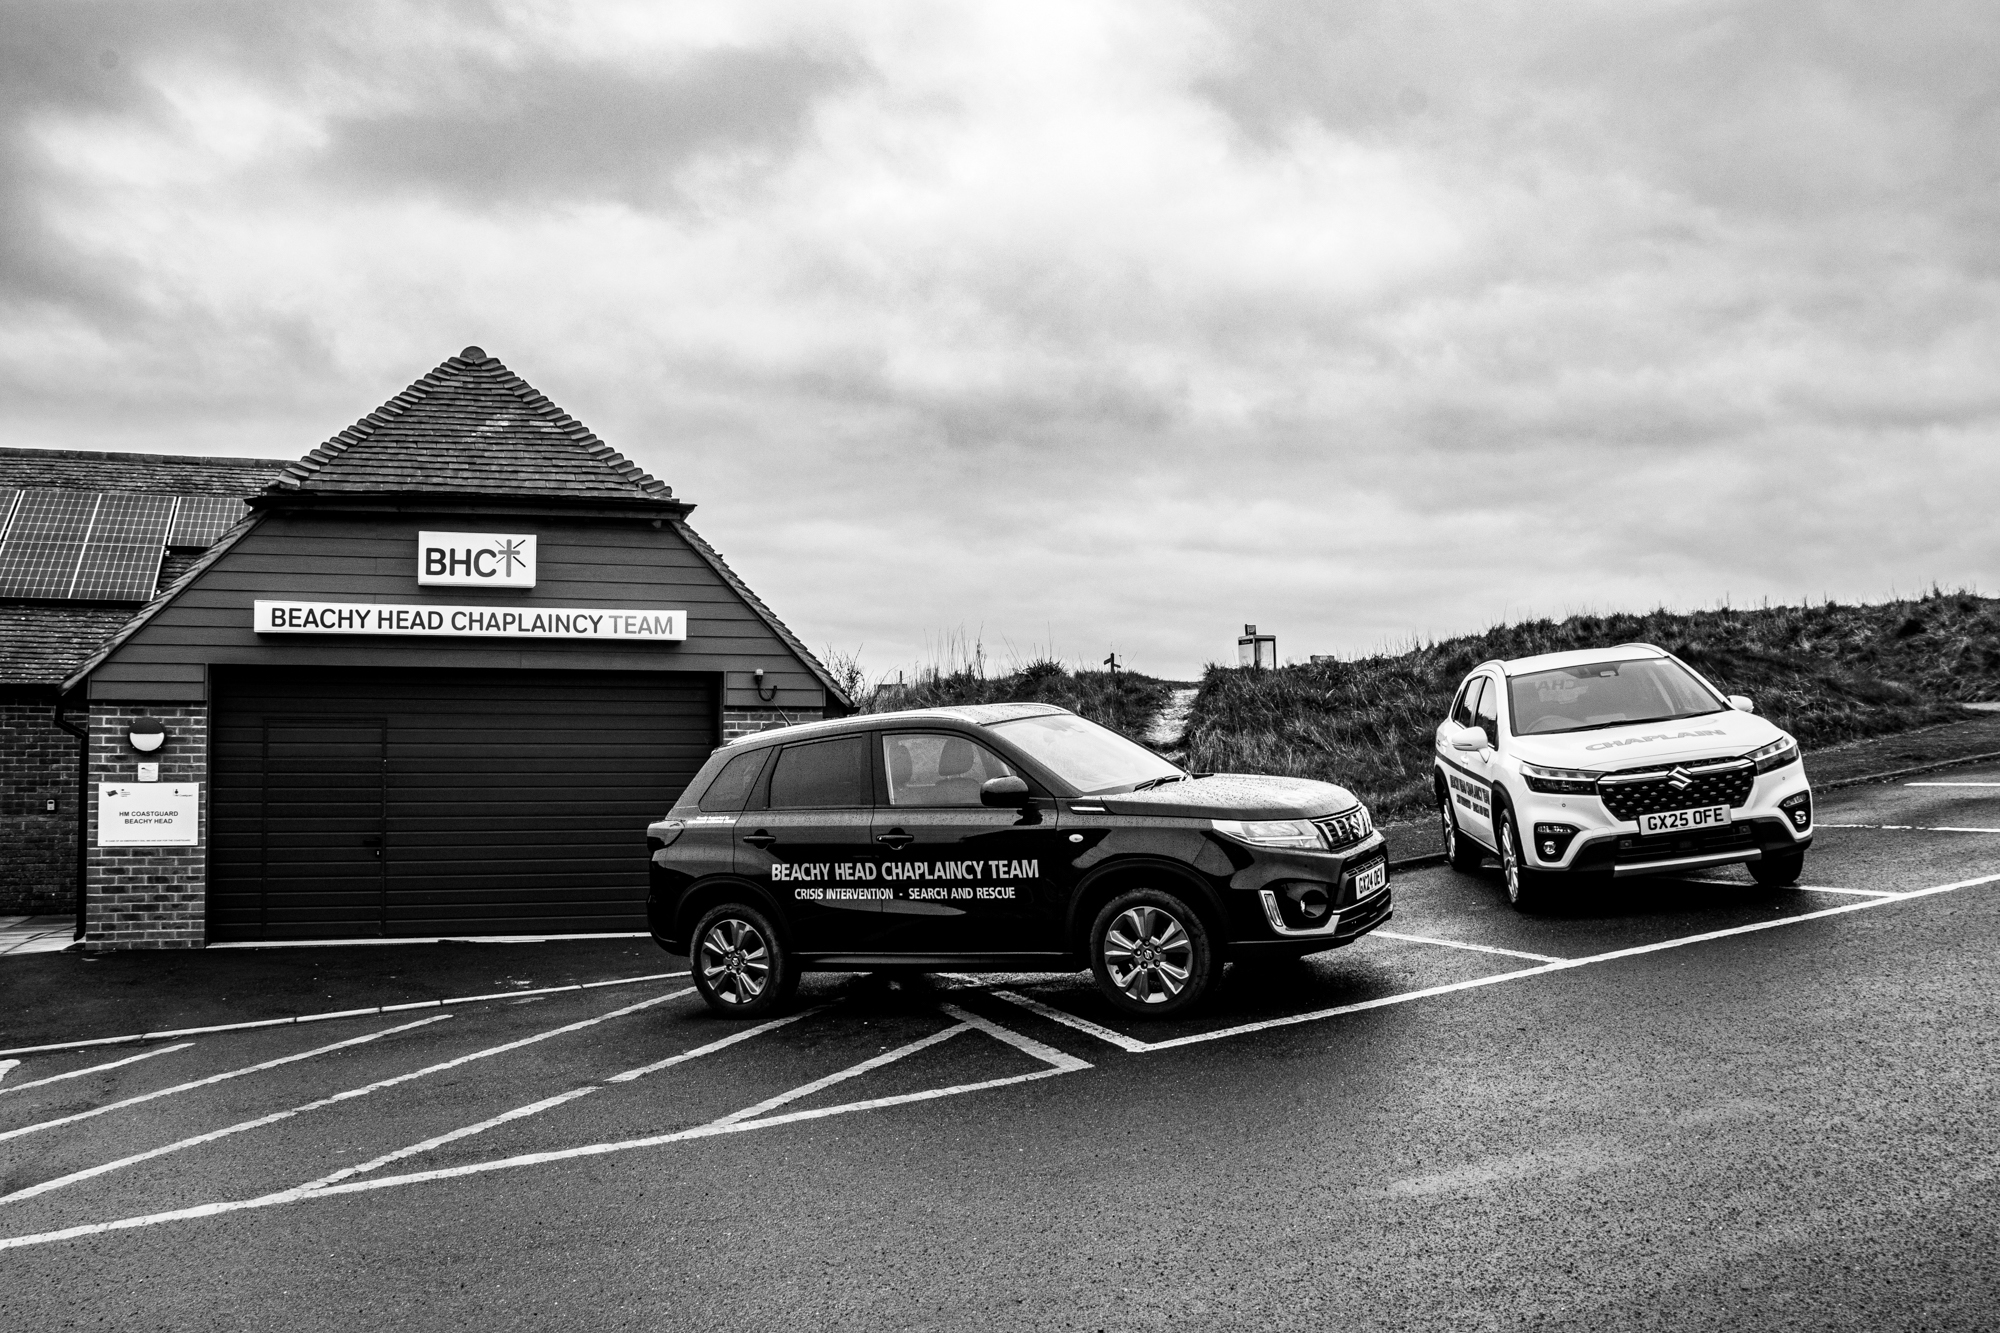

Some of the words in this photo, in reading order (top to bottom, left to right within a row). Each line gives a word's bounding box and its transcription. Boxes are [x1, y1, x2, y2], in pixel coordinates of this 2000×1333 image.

[271, 607, 371, 629] BEACHY
[378, 610, 444, 631] HEAD
[450, 611, 603, 634] CHAPLAINCY
[609, 615, 673, 635] TEAM
[1585, 729, 1727, 751] CHAPLAIN
[1647, 811, 1689, 831] GX25
[1693, 807, 1724, 825] OFE
[771, 863, 830, 881] BEACHY
[834, 862, 877, 880] HEAD
[881, 861, 984, 880] CHAPLAINCY
[989, 859, 1039, 879] TEAM
[794, 888, 824, 900] CRISIS
[826, 888, 893, 900] INTERVENTION
[908, 887, 948, 899] SEARCH
[950, 887, 973, 899] AND
[976, 887, 1016, 899] RESCUE
